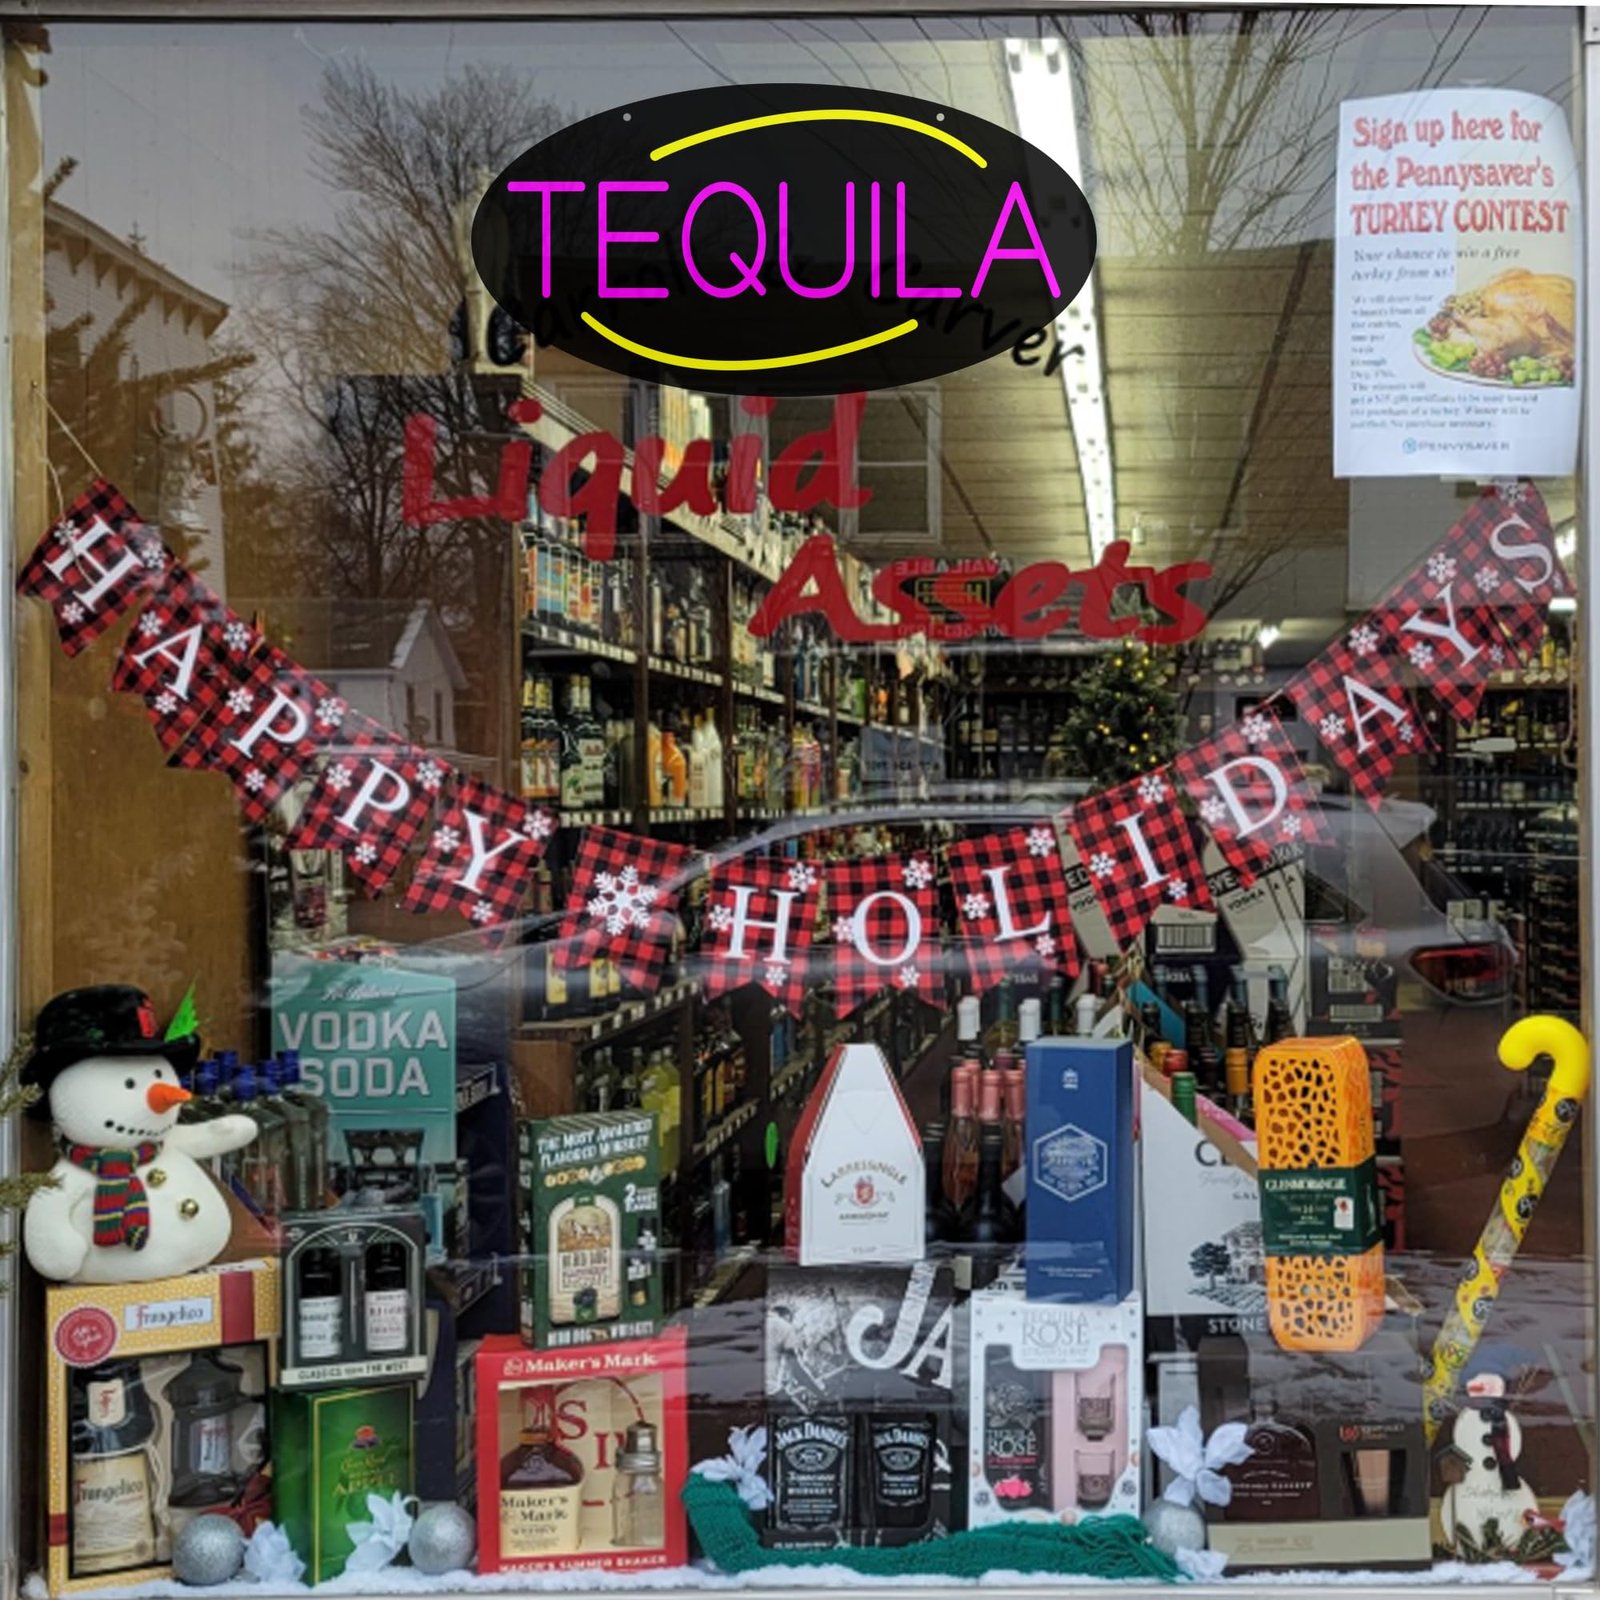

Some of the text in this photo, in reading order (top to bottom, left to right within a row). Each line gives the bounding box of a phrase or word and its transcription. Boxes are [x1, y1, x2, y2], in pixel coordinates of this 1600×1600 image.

[1353, 109, 1542, 150] Sign up here for
[1351, 157, 1553, 191] the Pennysaver's
[1351, 199, 1569, 236] TURKEY CONTEST
[507, 181, 1061, 298] TEQUILA
[1387, 246, 1434, 260] chance
[1481, 249, 1491, 259] a
[1493, 245, 1520, 260] free
[1351, 267, 1393, 281] turkey
[1396, 267, 1430, 281] from
[403, 388, 872, 561] Liquid
[748, 534, 1213, 645] Assets
[277, 1010, 449, 1051] VODKA
[297, 1057, 431, 1098] SODA
[1021, 1321, 1091, 1348] ROSE
[525, 1352, 658, 1374] Maker's Mark
[989, 1438, 1038, 1457] ROSE
[500, 1495, 569, 1510] Maker's
[520, 1508, 569, 1522] Mark
